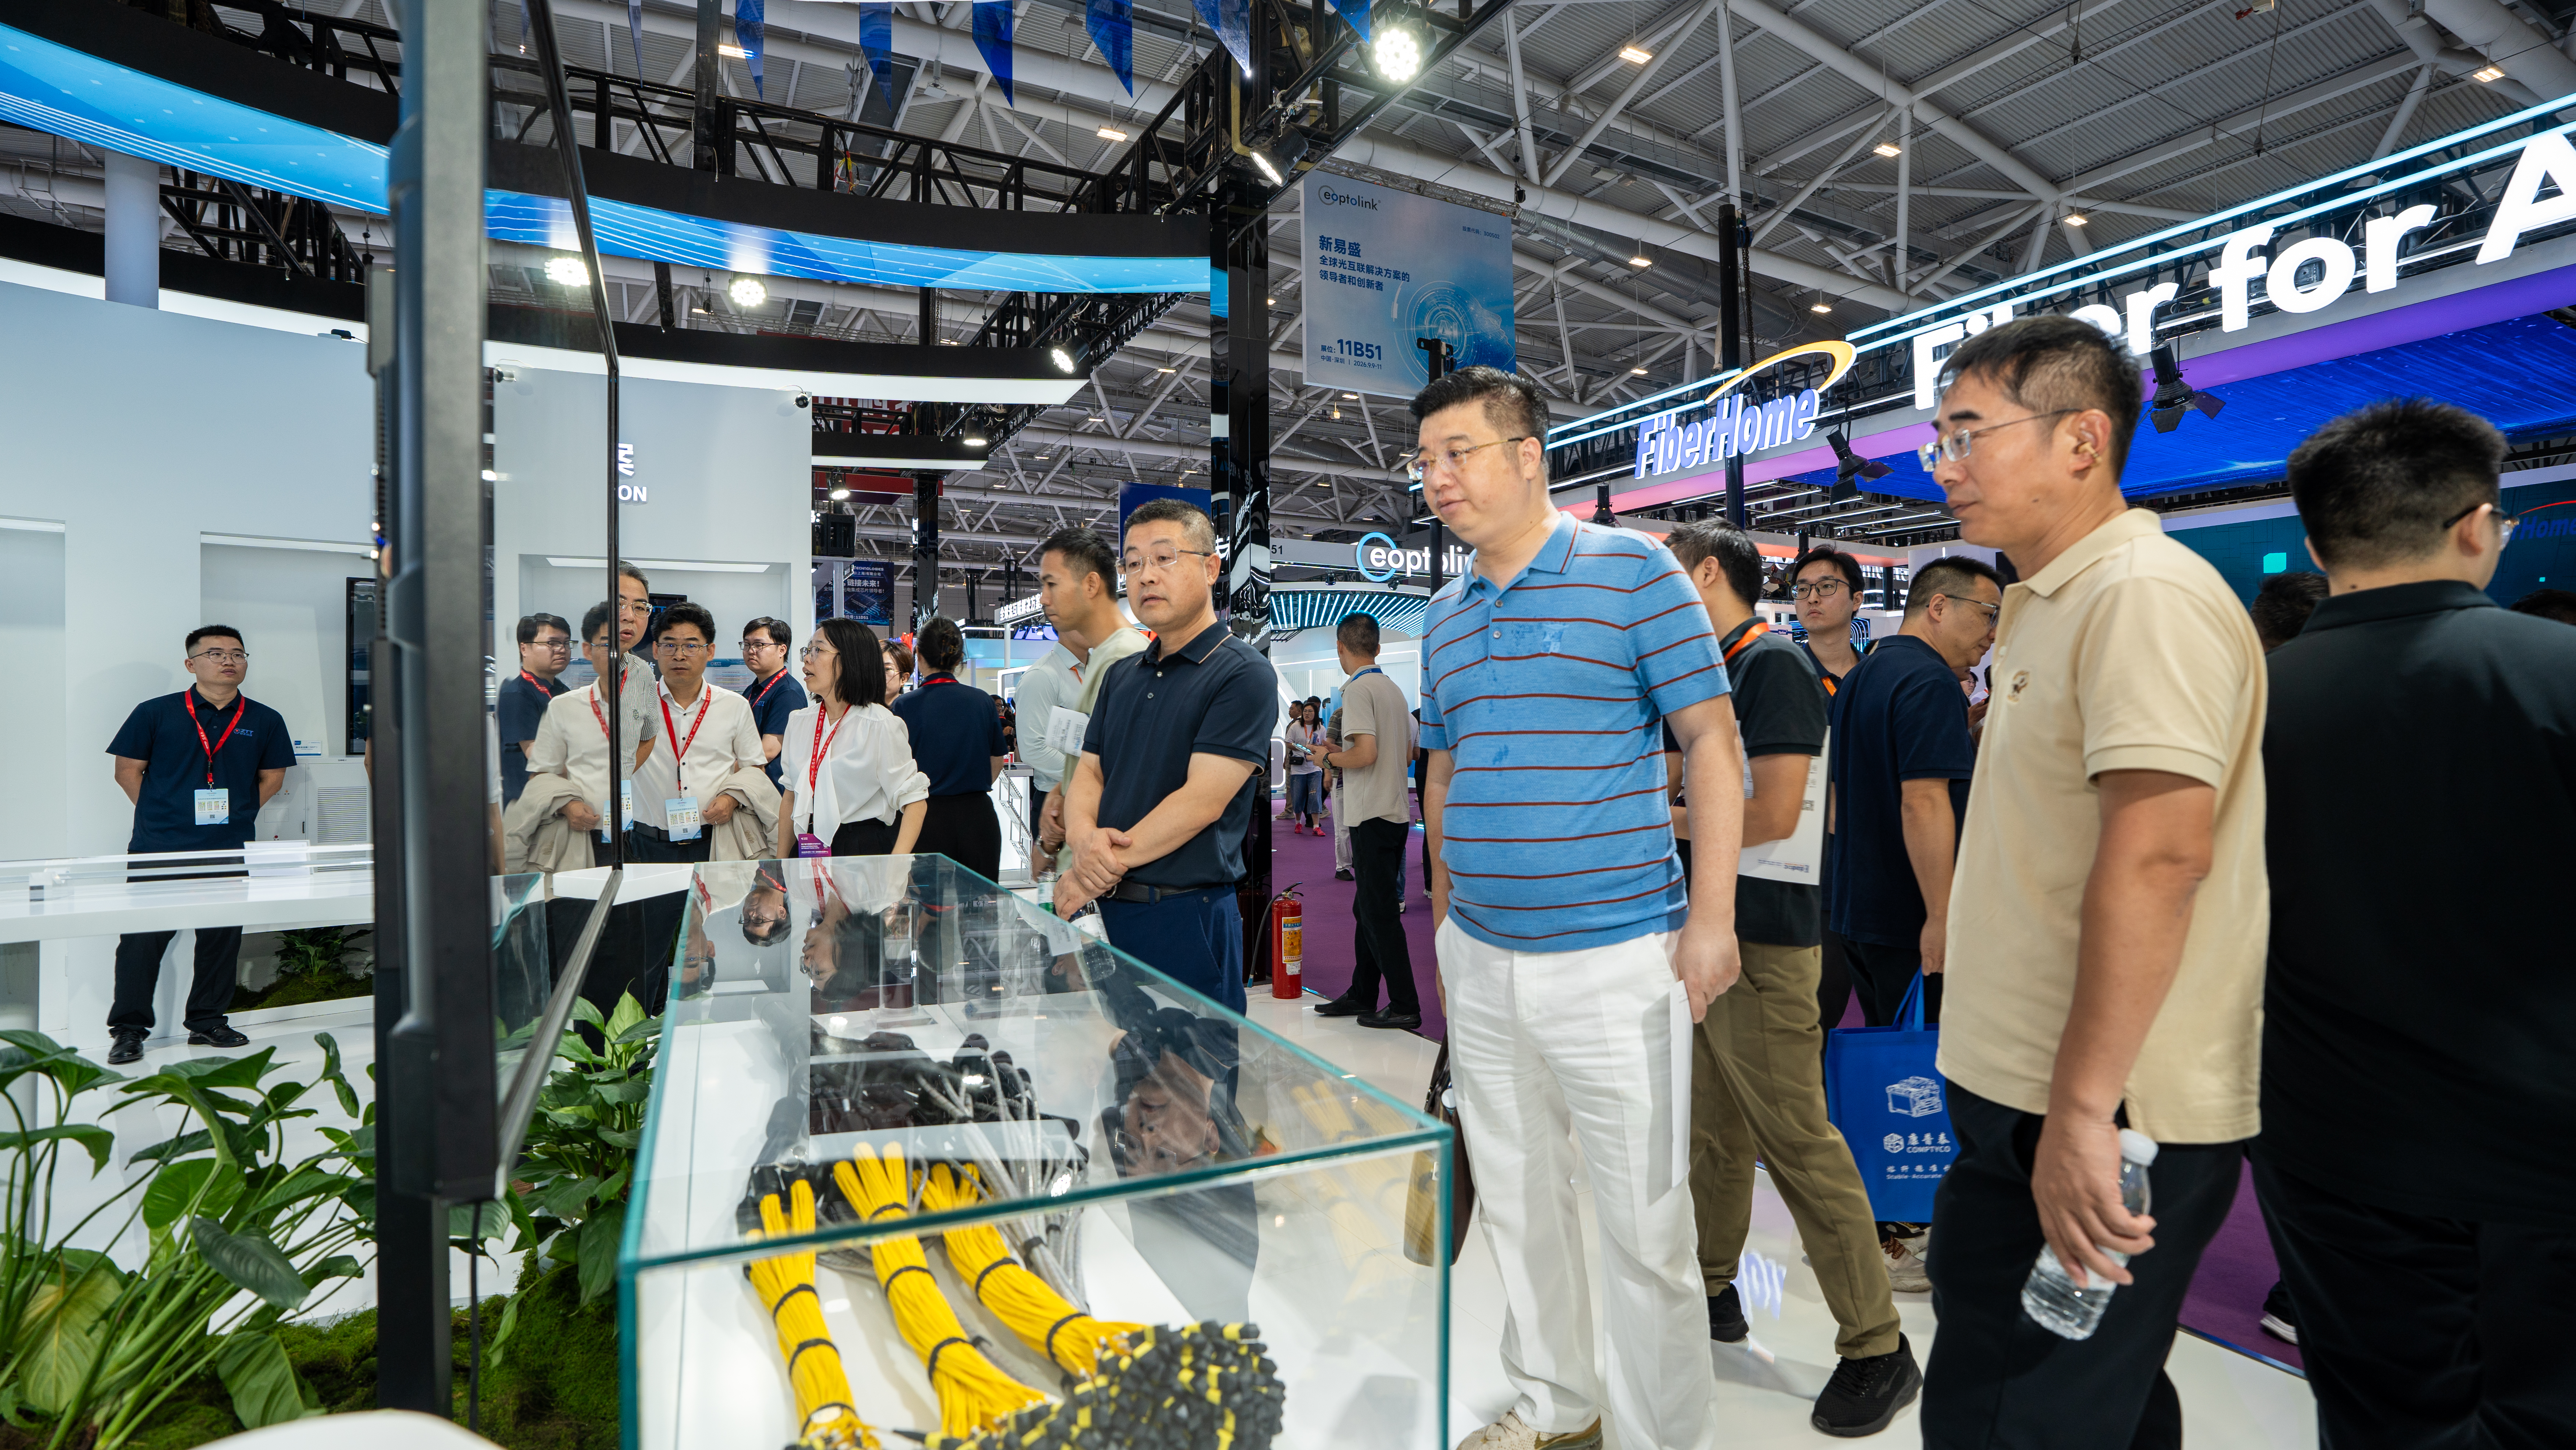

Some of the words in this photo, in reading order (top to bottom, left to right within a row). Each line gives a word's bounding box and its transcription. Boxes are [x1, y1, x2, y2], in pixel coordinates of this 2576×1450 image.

[1324, 191, 1378, 211] eoptolink
[1319, 235, 1361, 258] 新易盛
[1319, 255, 1410, 282] 全球光互联解决方案的
[2209, 204, 2437, 333] for
[1319, 269, 1384, 292] 领导者和创新者
[1337, 339, 1382, 360] 11B51
[1353, 360, 1382, 370] 2026.9.9-11
[1634, 388, 1820, 480] FiberHome
